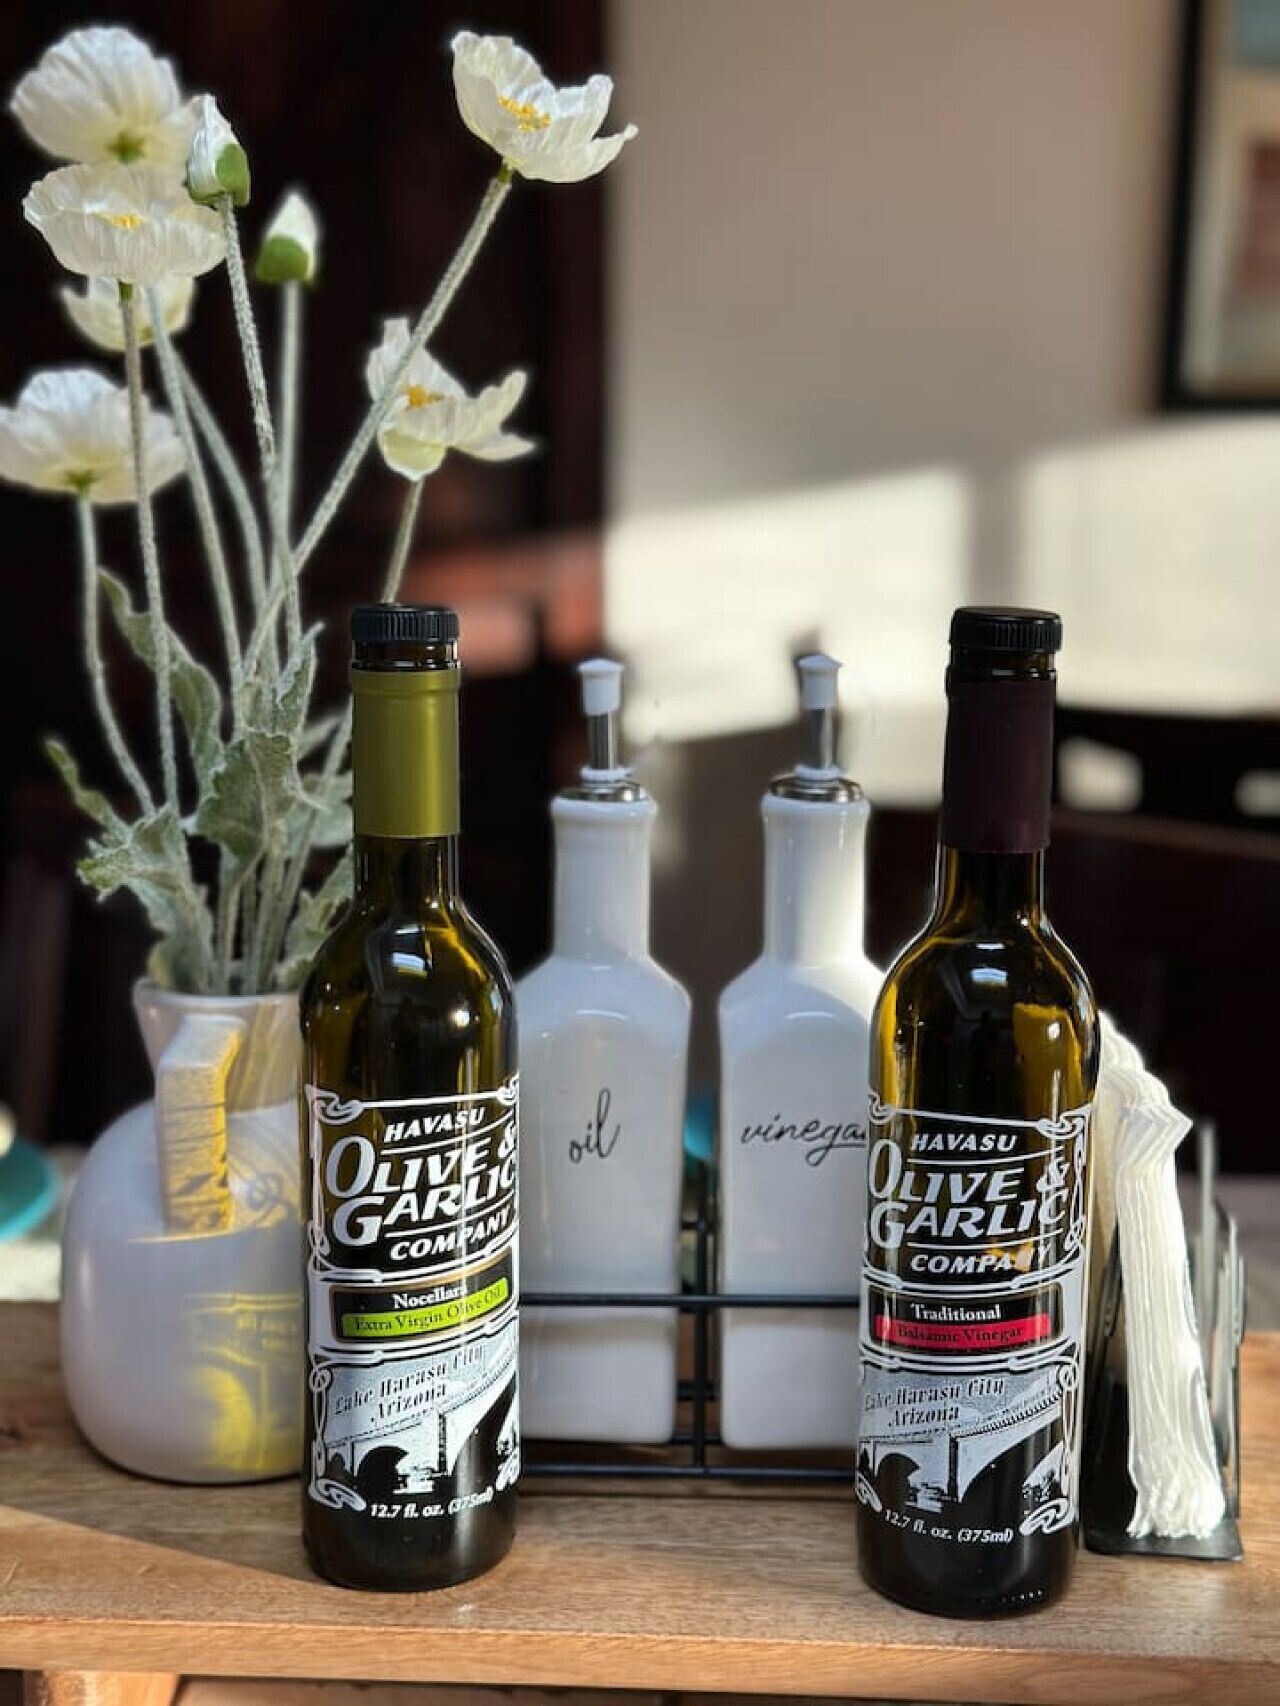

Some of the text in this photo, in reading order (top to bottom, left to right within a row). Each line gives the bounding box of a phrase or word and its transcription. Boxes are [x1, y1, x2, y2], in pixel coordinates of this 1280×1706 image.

[383, 1106, 485, 1143] HAVASU
[569, 1087, 620, 1164] oil
[741, 1114, 866, 1167] vinega
[911, 1133, 1018, 1152] HAVASU
[326, 1135, 492, 1199] OLIVE
[868, 1138, 1025, 1204] OLIVE
[332, 1152, 517, 1247] GARLIC
[389, 1203, 511, 1261] COMPANY
[870, 1188, 1069, 1250] GARLIC
[910, 1243, 1052, 1274] COMPAY
[395, 1311, 443, 1329] Virgin
[910, 1303, 1003, 1322] Traditional
[961, 1328, 1022, 1343] Vinegar
[369, 1383, 447, 1424] Arizona
[886, 1405, 961, 1428] Arizona
[370, 1504, 403, 1519] 12.7
[885, 1508, 911, 1528] 12.7
[957, 1527, 1014, 1543] (375ml)
